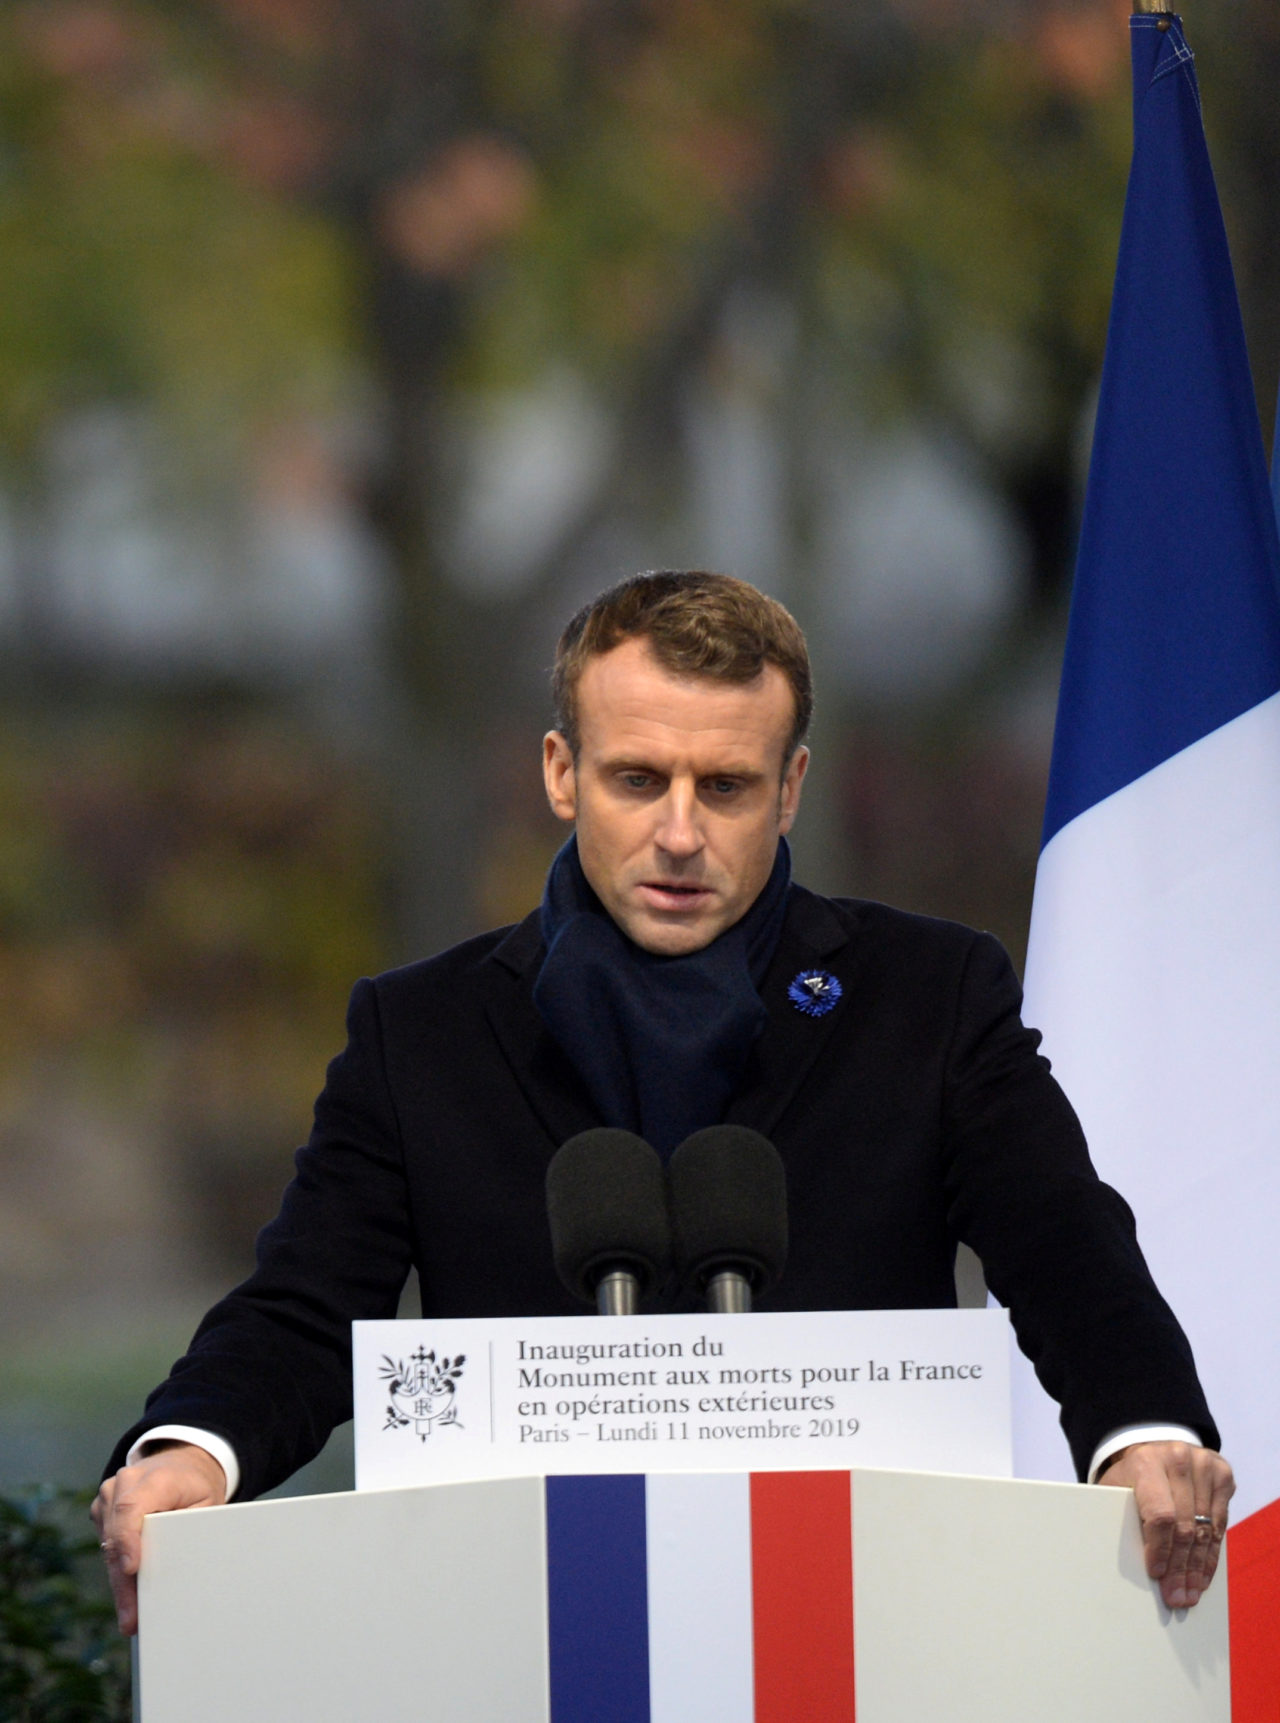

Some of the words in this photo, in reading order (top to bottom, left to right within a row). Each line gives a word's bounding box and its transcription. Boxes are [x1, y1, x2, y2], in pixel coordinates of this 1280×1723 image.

[517, 1337, 684, 1365] Inauguration
[692, 1336, 724, 1358] du
[518, 1368, 658, 1388] Monument
[665, 1370, 711, 1386] aux
[719, 1367, 793, 1385] morts
[800, 1367, 861, 1389] pour
[868, 1360, 890, 1381] la
[899, 1360, 982, 1381] France
[517, 1402, 548, 1416] en
[555, 1393, 691, 1421] opérations
[697, 1390, 835, 1413] extérieures
[519, 1423, 569, 1443] Paris
[597, 1421, 657, 1441] Lundi
[667, 1421, 689, 1440] 11
[698, 1418, 800, 1440] novembre
[808, 1418, 860, 1438] 2019
